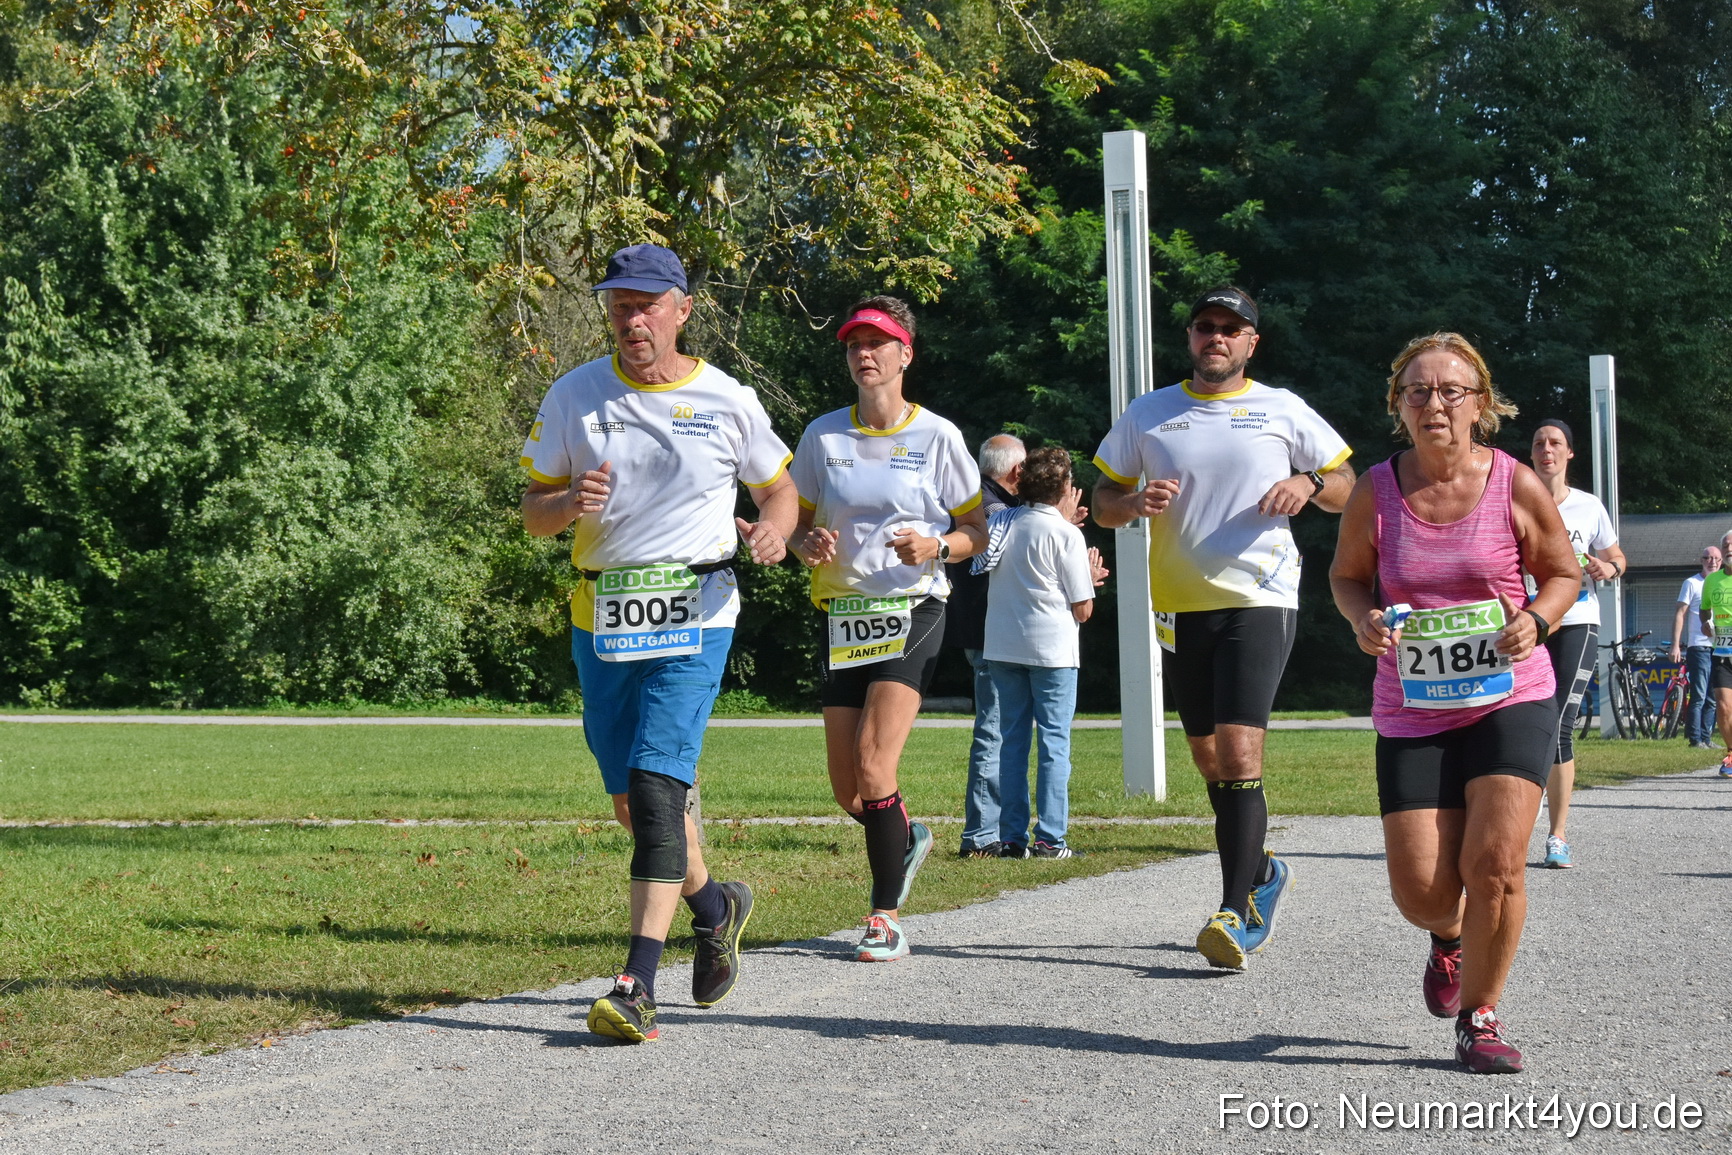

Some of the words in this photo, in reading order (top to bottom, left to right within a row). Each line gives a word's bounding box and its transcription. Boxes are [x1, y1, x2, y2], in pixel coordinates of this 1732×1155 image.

[672, 405, 693, 419] 20
[1231, 408, 1248, 417] 20
[590, 421, 625, 431] BOCK
[672, 420, 720, 431] Neumarkter
[1160, 421, 1190, 430] BOCK
[671, 429, 710, 439] Stadtlauf
[892, 446, 908, 457] 20
[826, 457, 854, 466] BOCK
[889, 463, 920, 473] Stadtlauf
[890, 457, 927, 466] Neumarkter
[602, 566, 691, 592] BOCK
[834, 596, 902, 613] BOCK
[605, 595, 690, 629] 3005
[1401, 605, 1498, 637] BOCK
[839, 615, 903, 642] 1059
[603, 632, 690, 650] WOLFGANG
[847, 643, 891, 659] JANETT
[1407, 639, 1498, 675] 2184
[1426, 680, 1485, 698] HELGA
